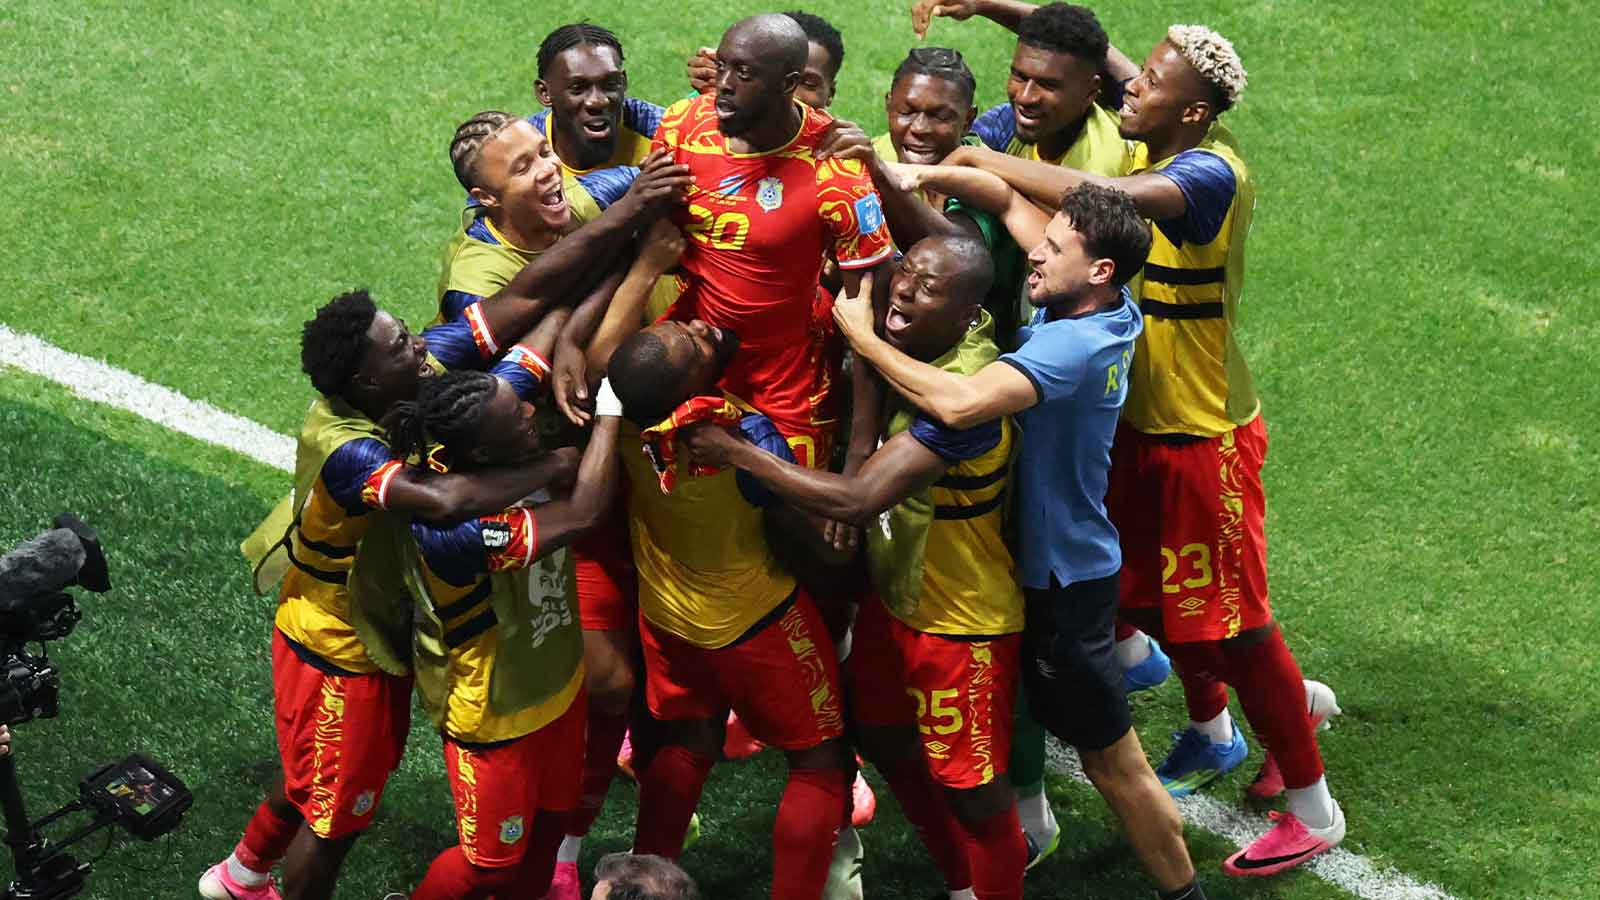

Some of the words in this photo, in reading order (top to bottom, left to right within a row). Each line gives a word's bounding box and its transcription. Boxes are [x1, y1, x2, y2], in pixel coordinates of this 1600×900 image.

[686, 204, 750, 250] 20
[1161, 543, 1213, 593] 23
[906, 688, 963, 736] 25
